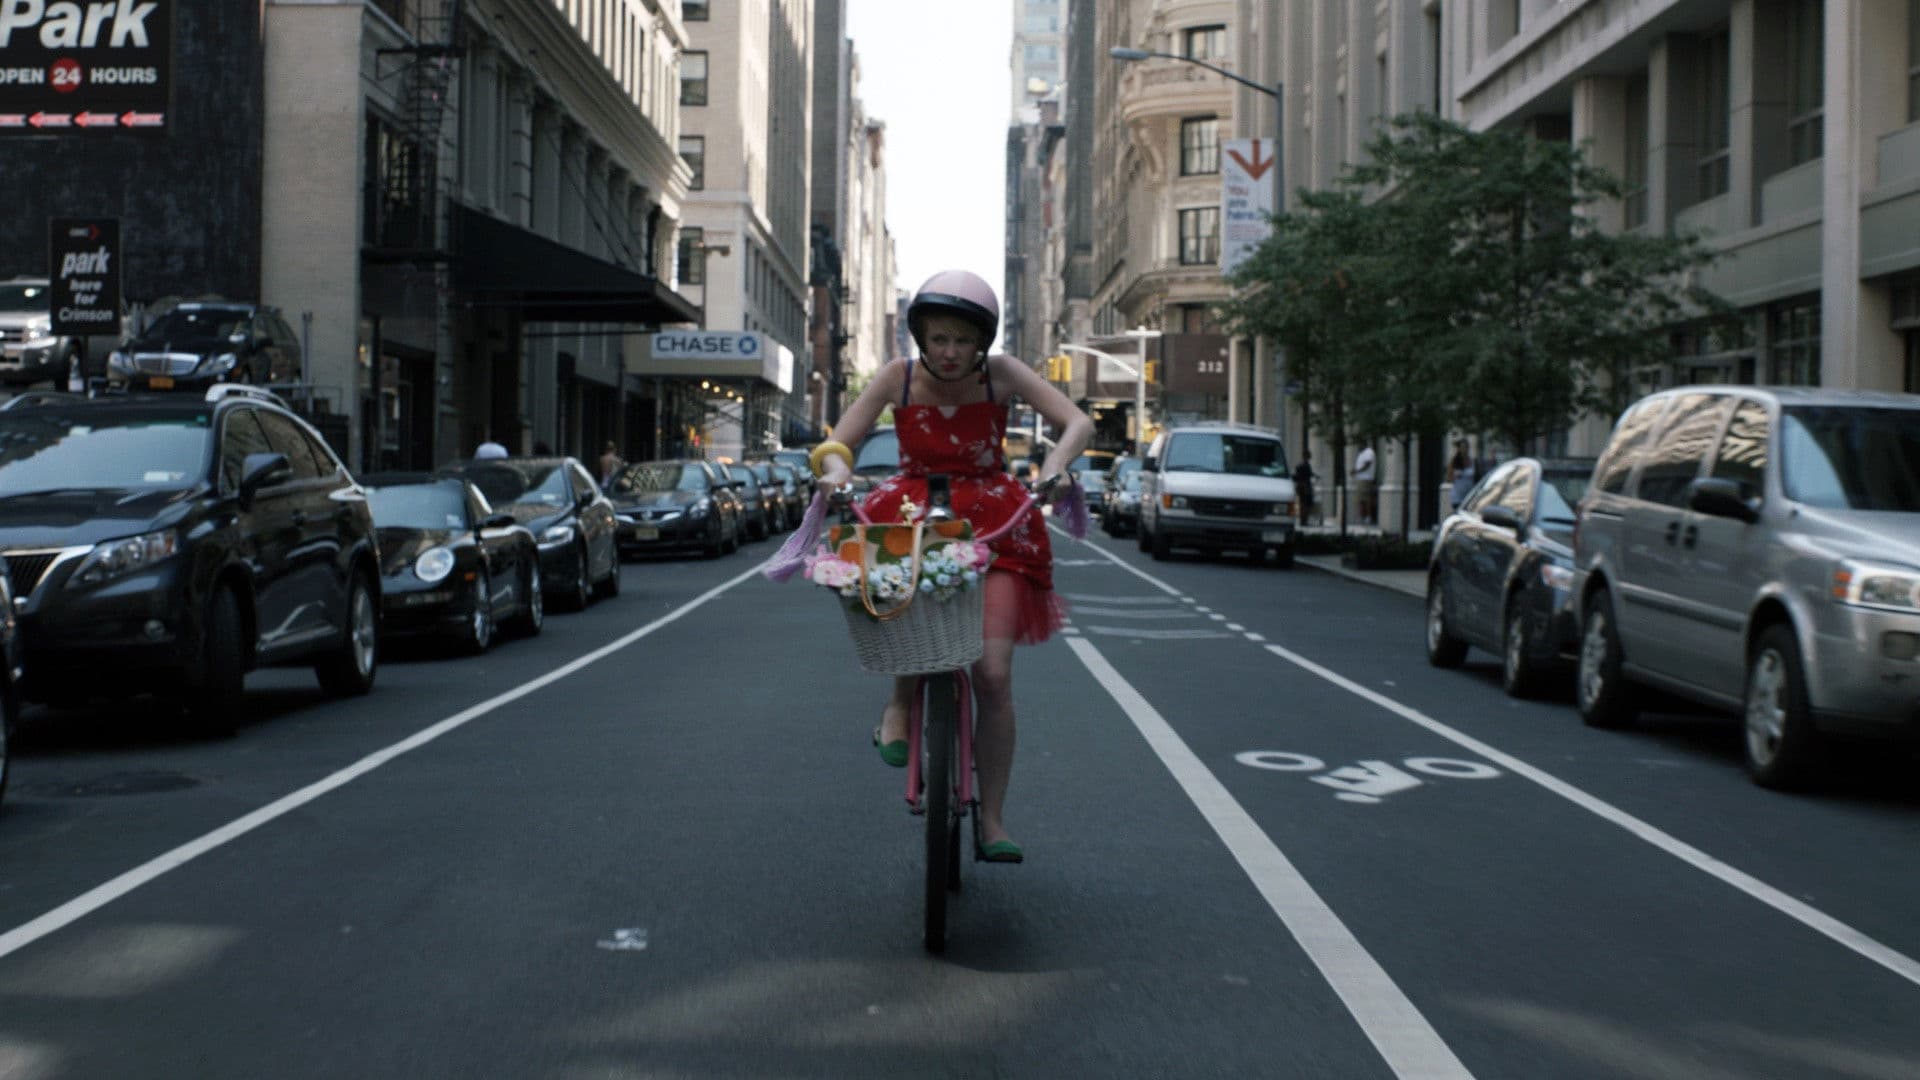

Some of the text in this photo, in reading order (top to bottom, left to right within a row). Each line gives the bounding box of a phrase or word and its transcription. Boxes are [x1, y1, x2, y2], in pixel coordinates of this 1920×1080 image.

[0, 0, 157, 49] Park
[52, 67, 82, 85] 24
[90, 67, 157, 84] HOURS
[61, 246, 110, 279] park
[69, 279, 103, 292] here
[75, 292, 97, 305] for
[59, 307, 113, 322] Crimson
[655, 336, 733, 353] CHASE
